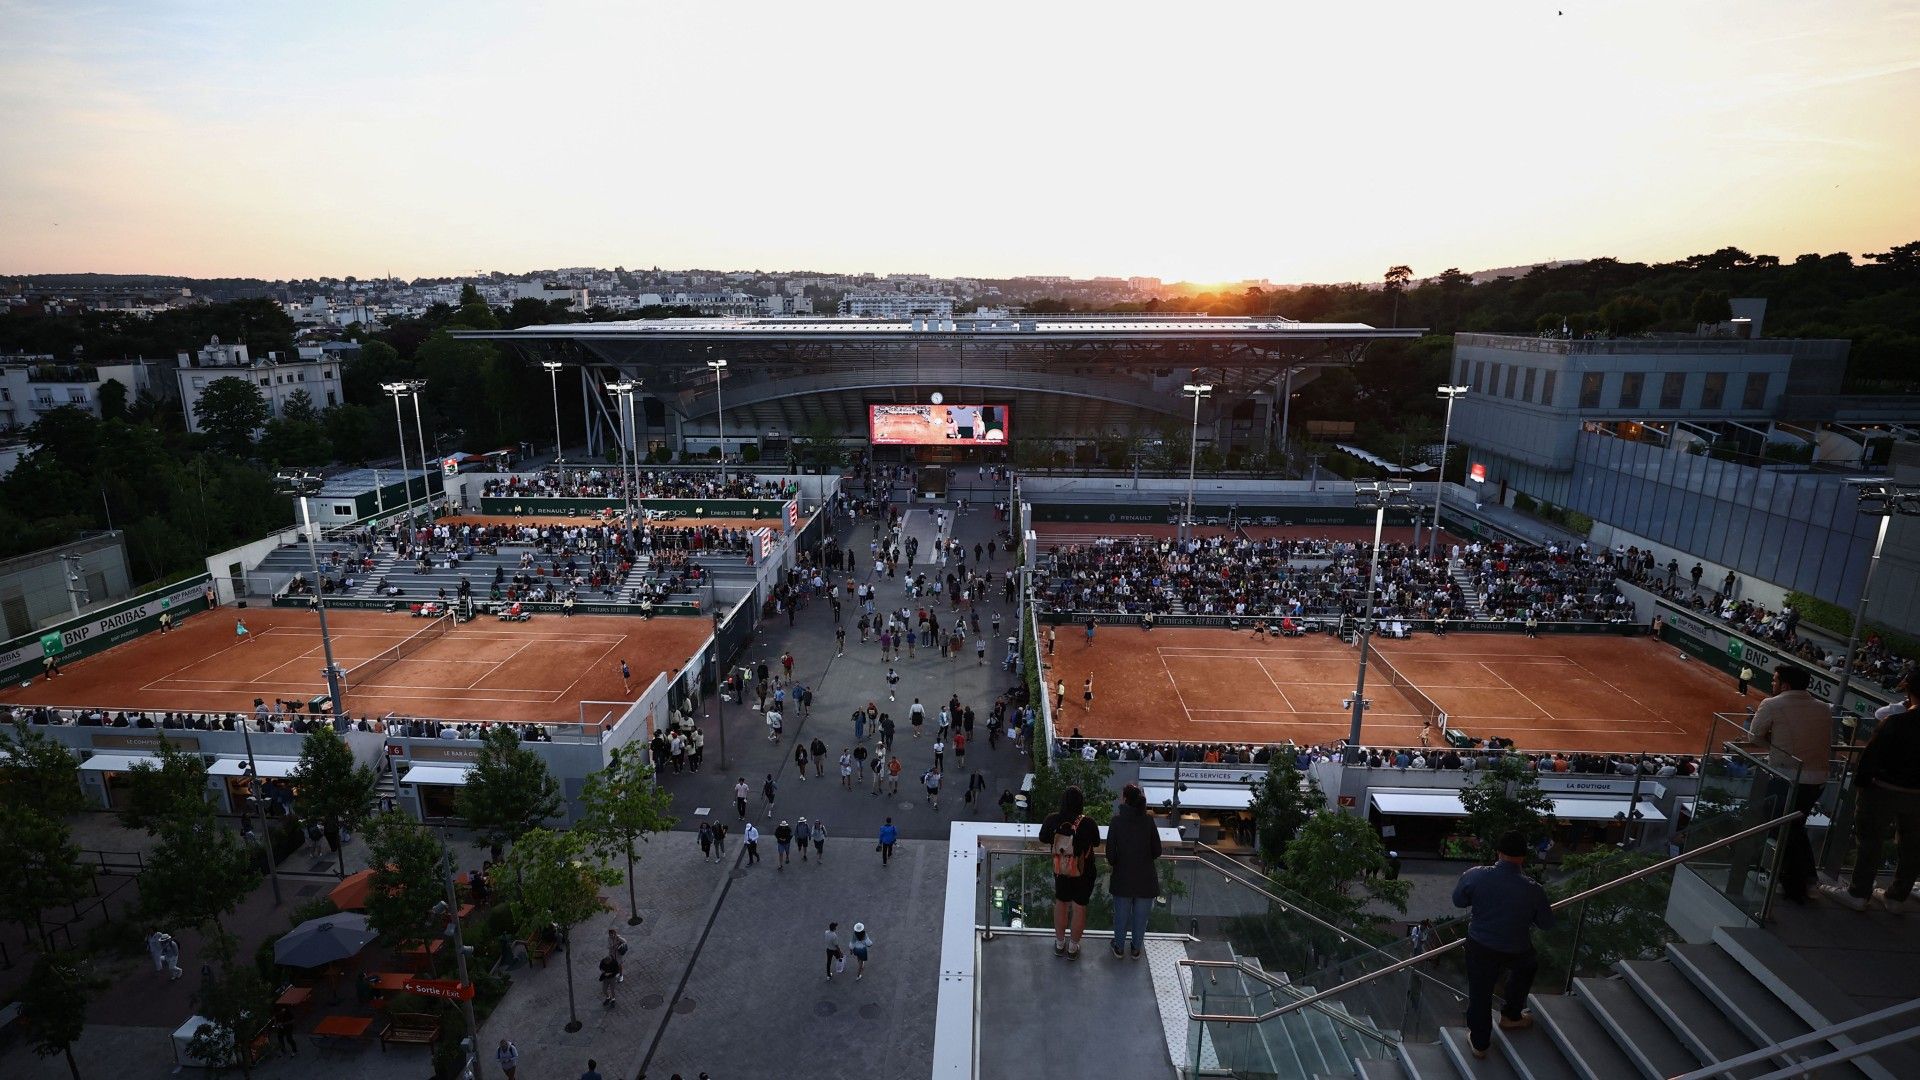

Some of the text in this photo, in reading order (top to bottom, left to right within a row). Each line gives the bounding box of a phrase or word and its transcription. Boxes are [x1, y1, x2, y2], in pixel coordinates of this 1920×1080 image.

[170, 586, 203, 602] BNP PARIBAS
[539, 604, 561, 612] oppo
[1158, 616, 1194, 625] Emirates
[64, 606, 147, 646] BNP PARIBAS
[1745, 647, 1769, 667] BNP
[393, 747, 400, 755] 6
[1200, 772, 1232, 780] SERVICES
[1345, 797, 1353, 806] 7
[416, 984, 440, 995] Sortie
[446, 989, 461, 998] Exit
